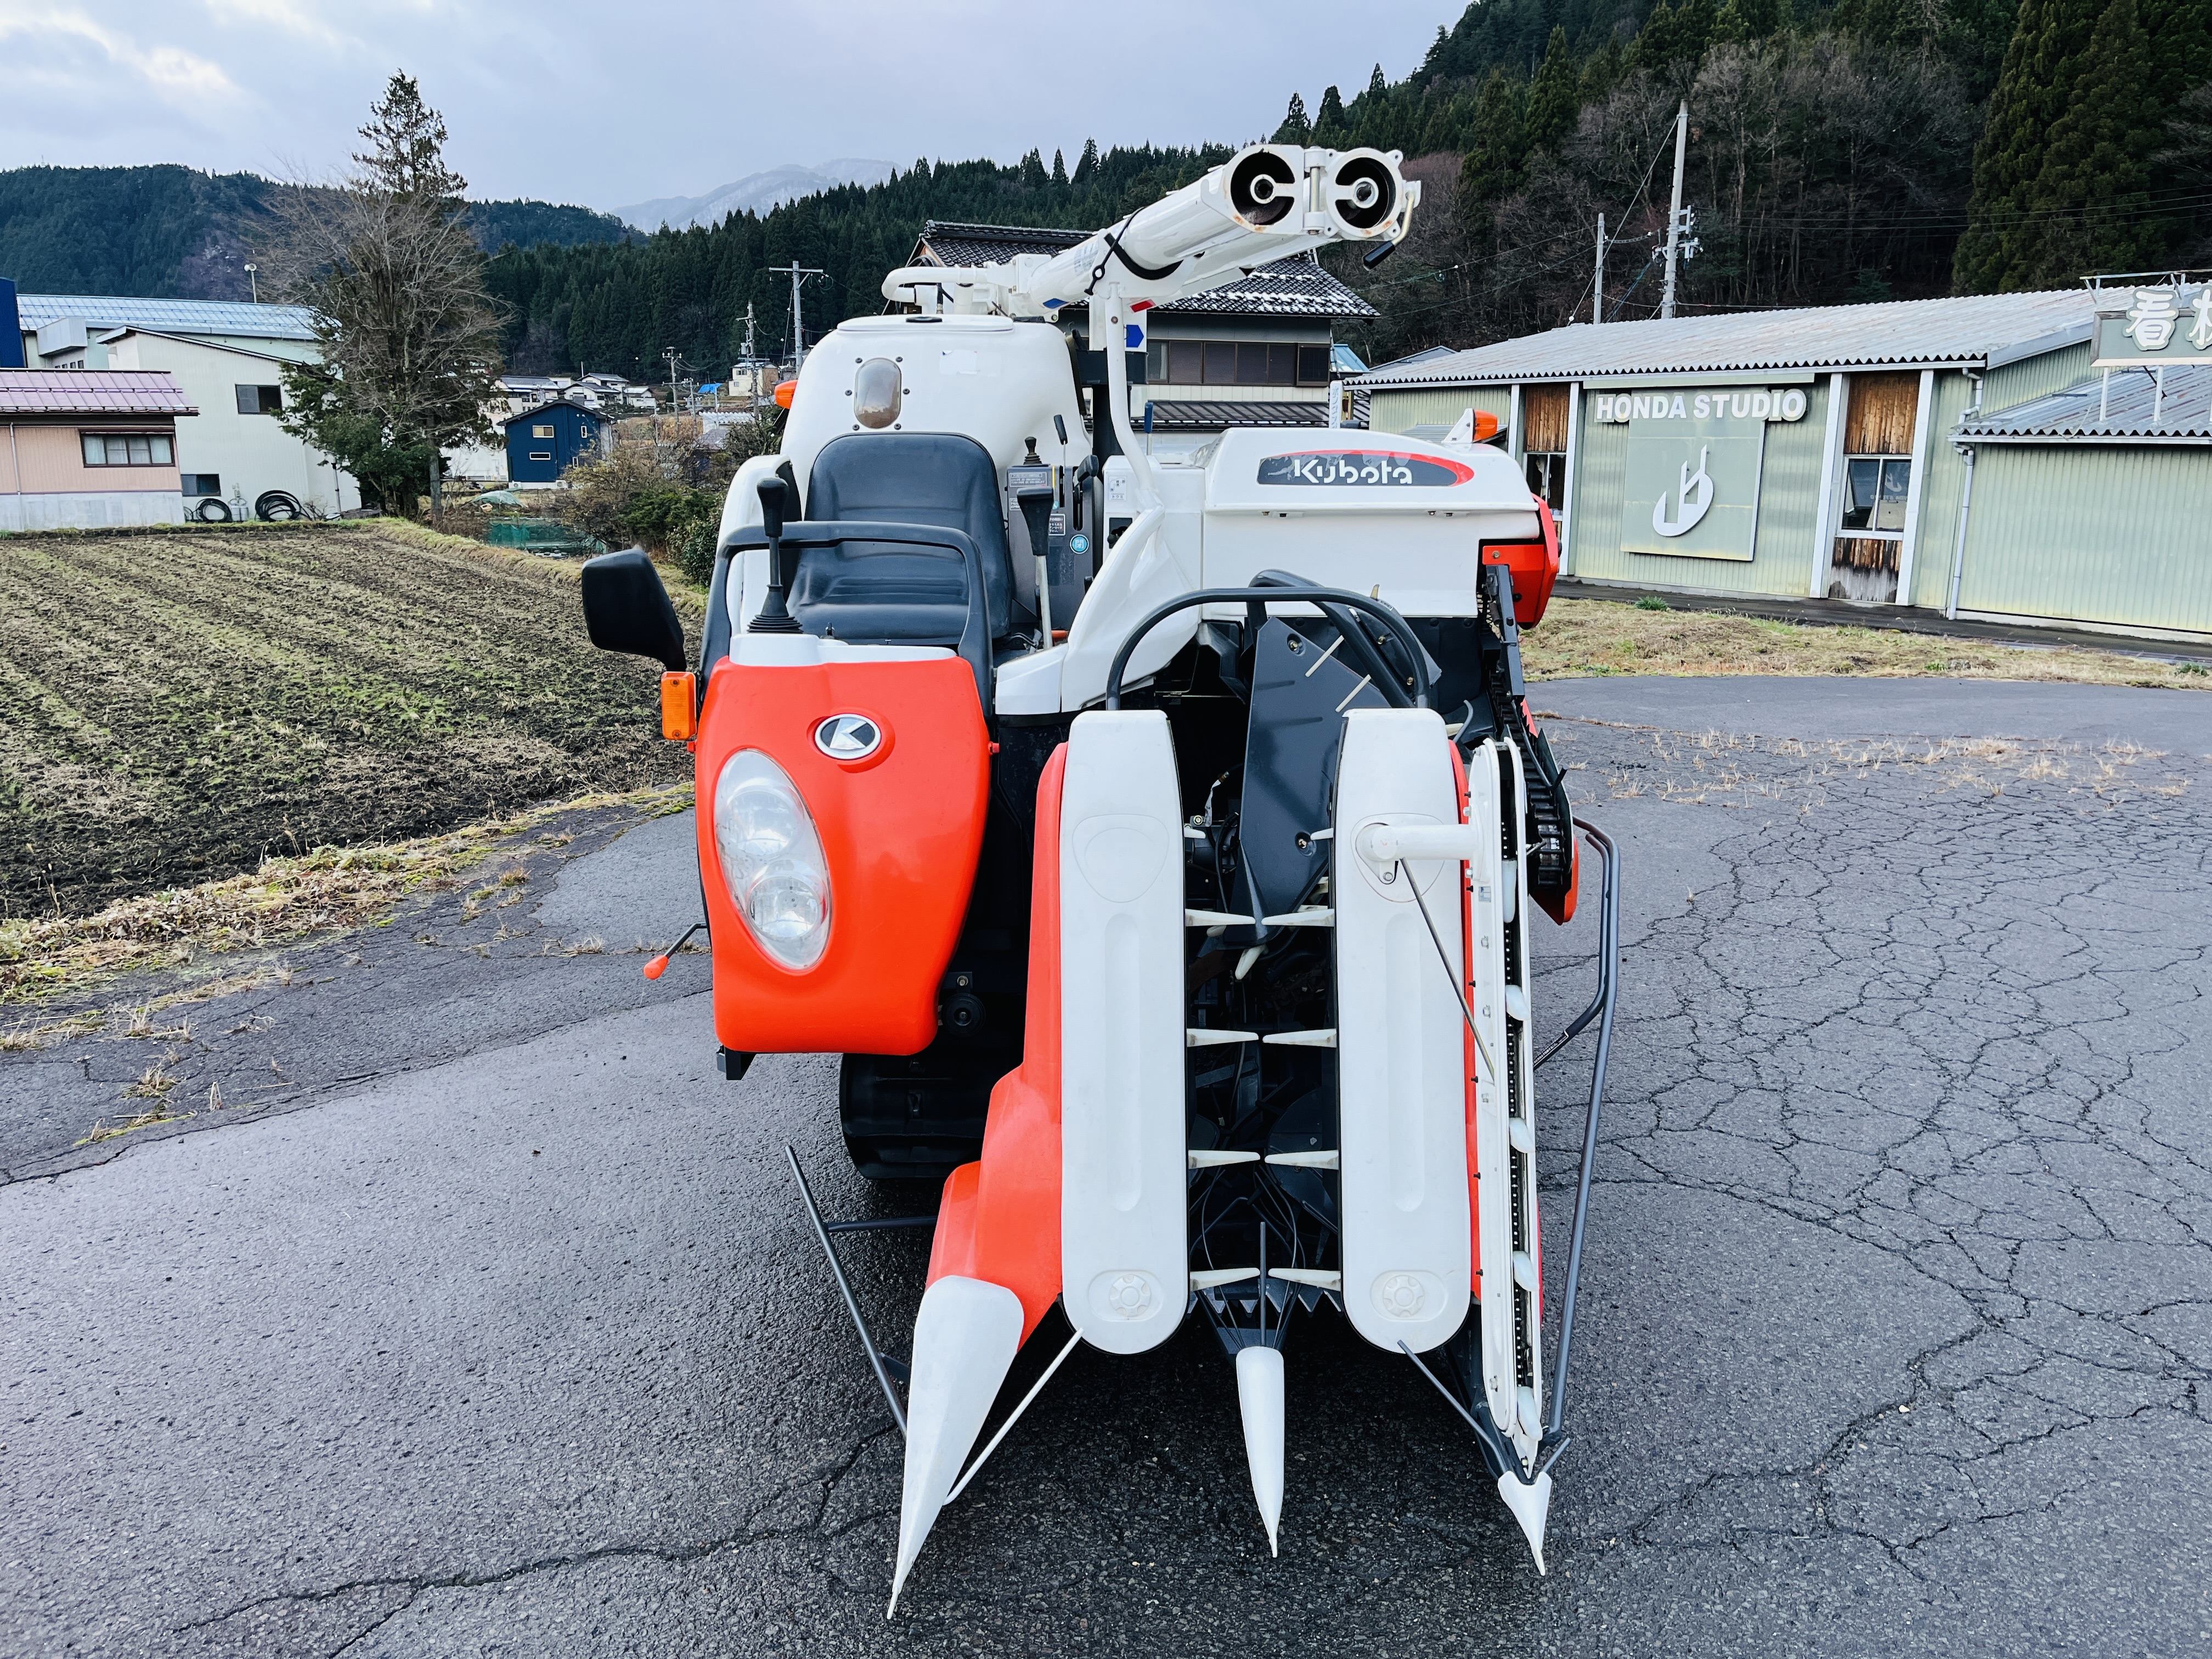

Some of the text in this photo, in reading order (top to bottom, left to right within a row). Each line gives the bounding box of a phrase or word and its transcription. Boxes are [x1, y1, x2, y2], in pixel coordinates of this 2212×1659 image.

[1597, 392, 1804, 419] HONDA STUDIO
[1294, 459, 1412, 484] Kubota
